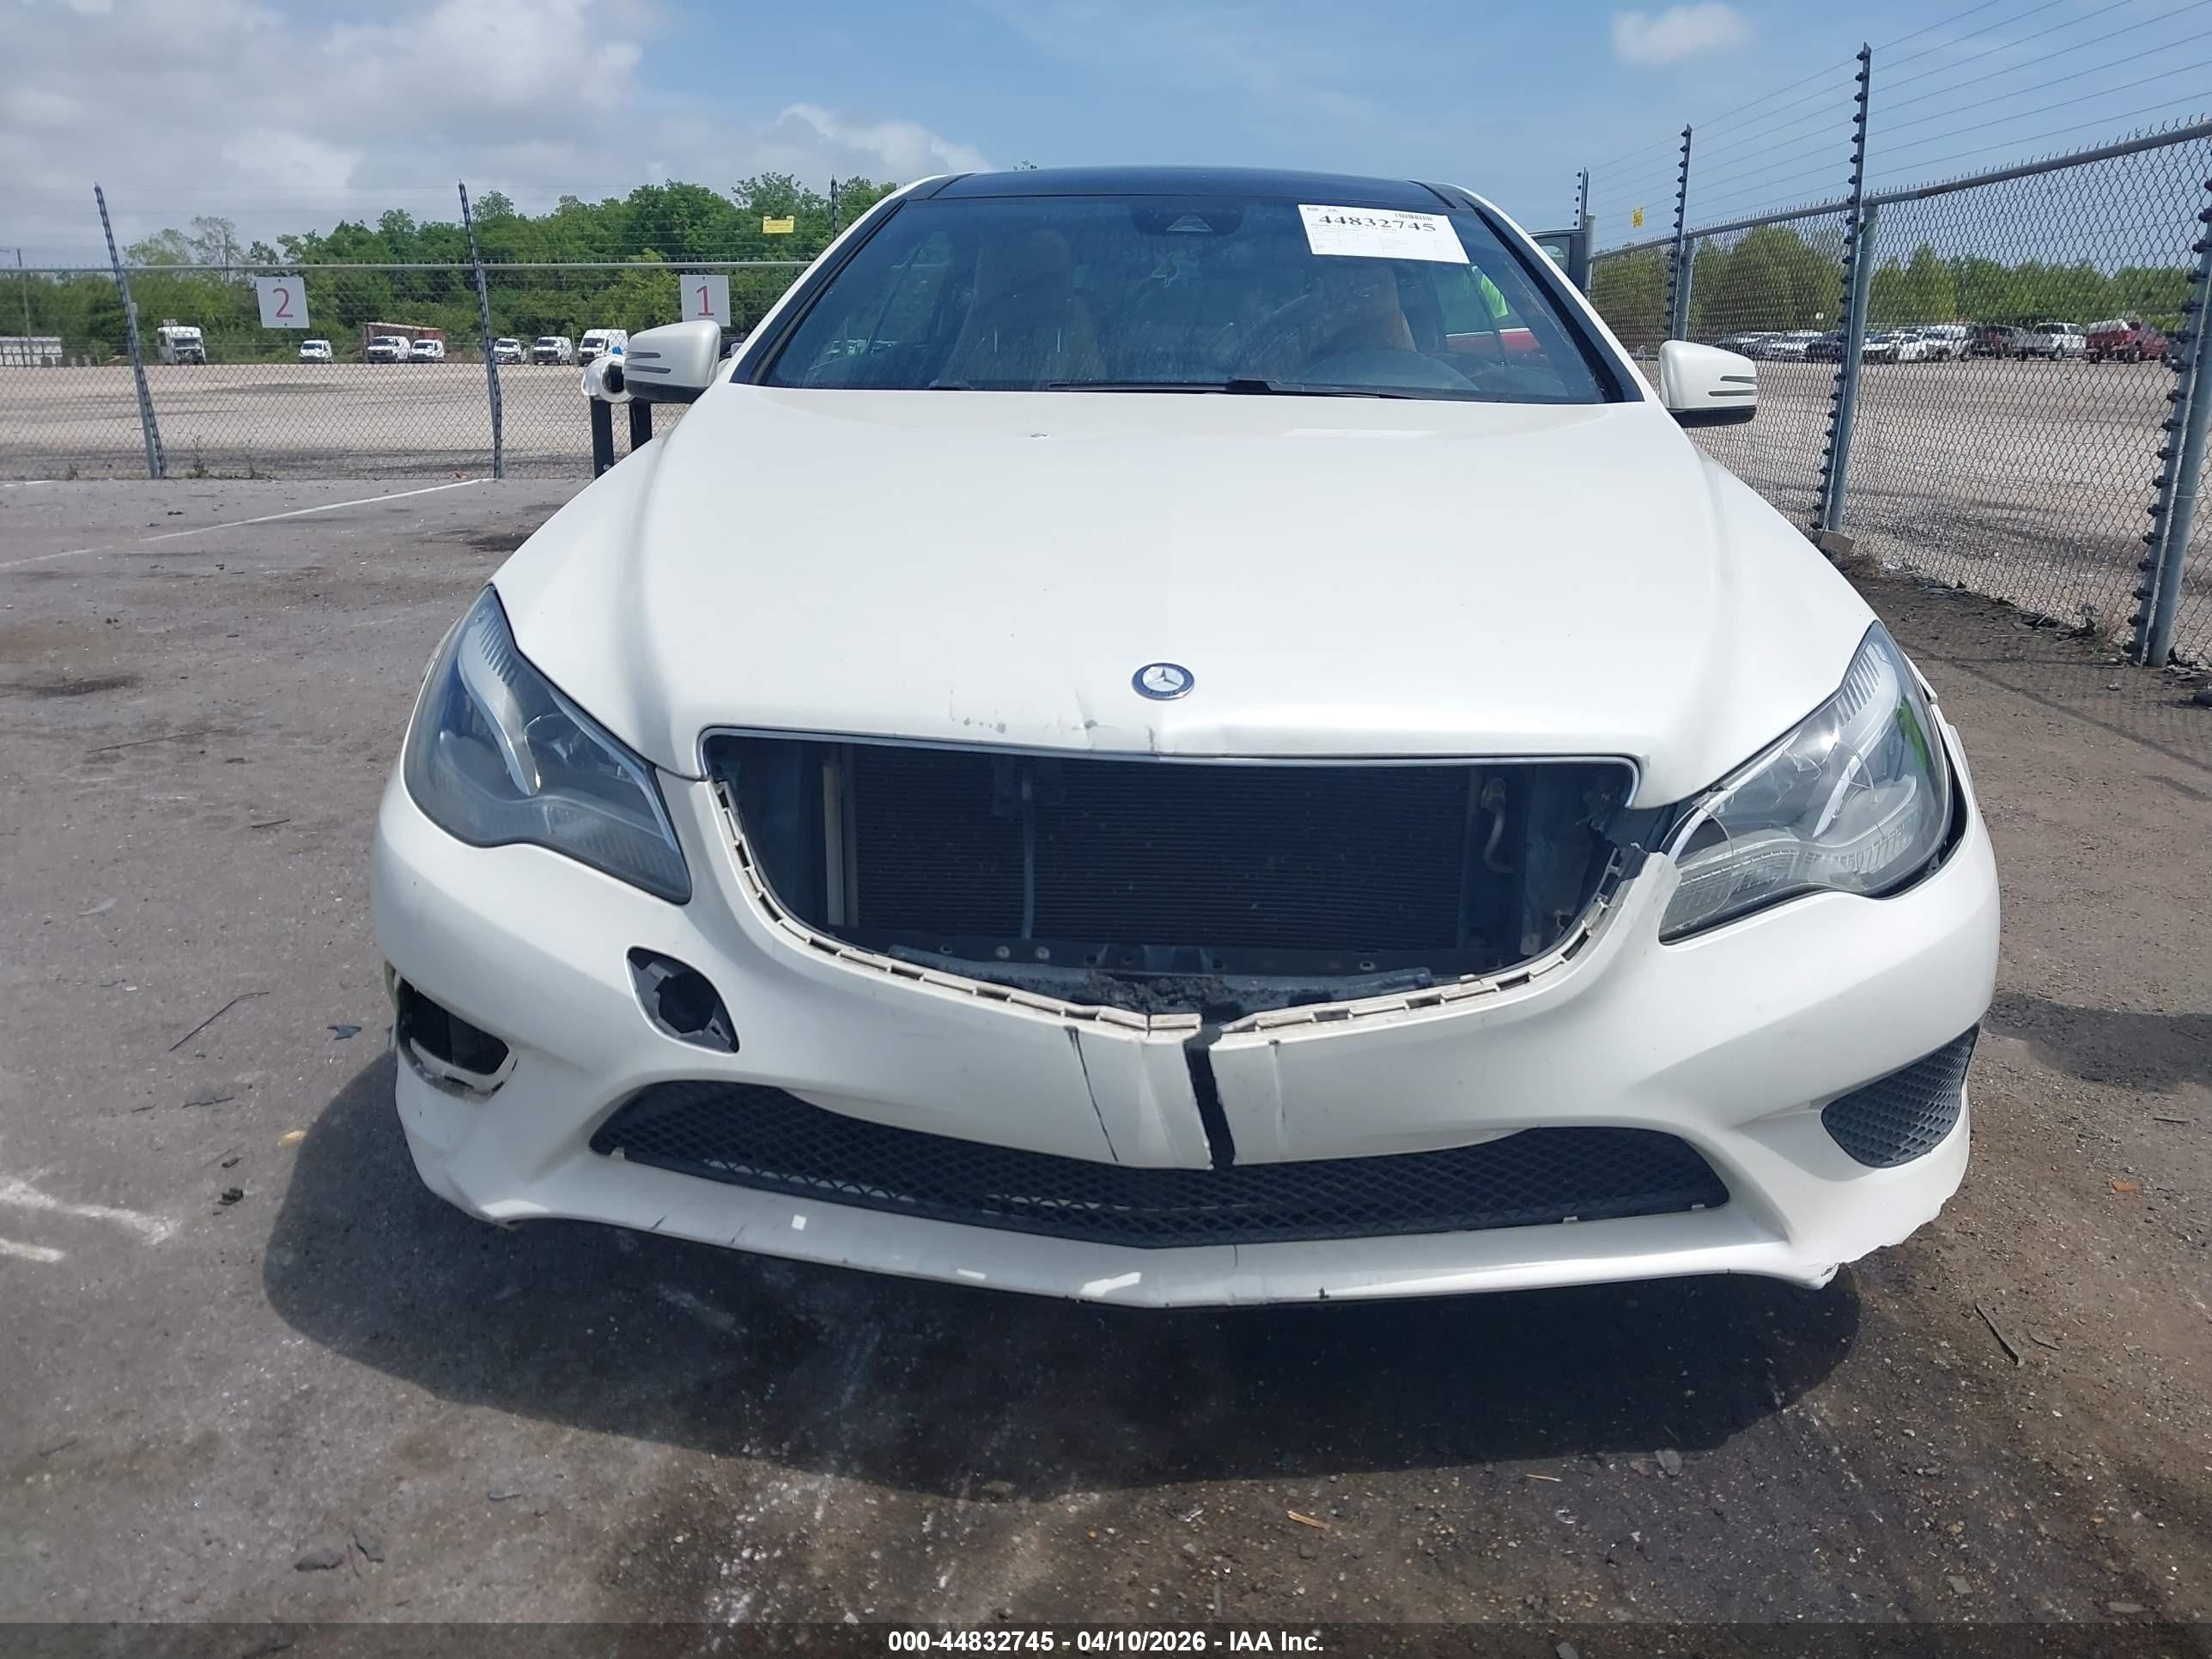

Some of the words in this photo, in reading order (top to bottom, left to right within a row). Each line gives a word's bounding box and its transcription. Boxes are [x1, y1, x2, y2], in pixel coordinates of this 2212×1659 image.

[1319, 214, 1437, 233] 44832745
[273, 288, 294, 318] 2
[696, 285, 715, 316] 1
